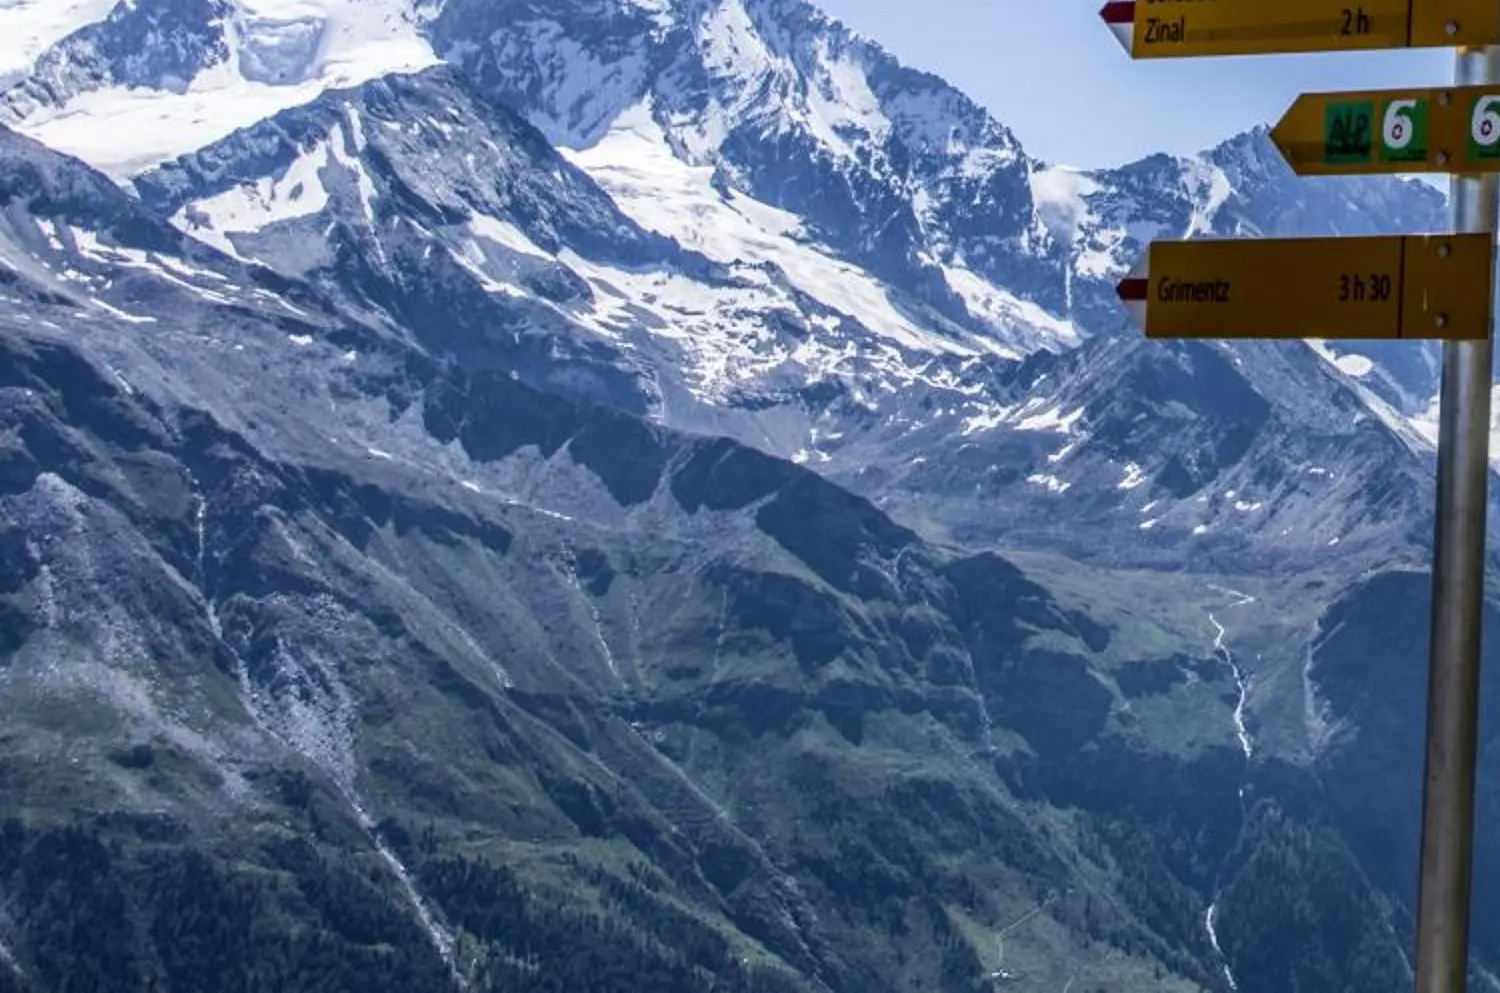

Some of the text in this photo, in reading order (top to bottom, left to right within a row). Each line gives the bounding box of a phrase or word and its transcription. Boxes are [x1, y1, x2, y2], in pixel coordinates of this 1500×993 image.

[1144, 7, 1370, 44] Zinal 2 h
[1383, 99, 1416, 149] 6
[1157, 273, 1391, 303] Grimentz 3 h 30
